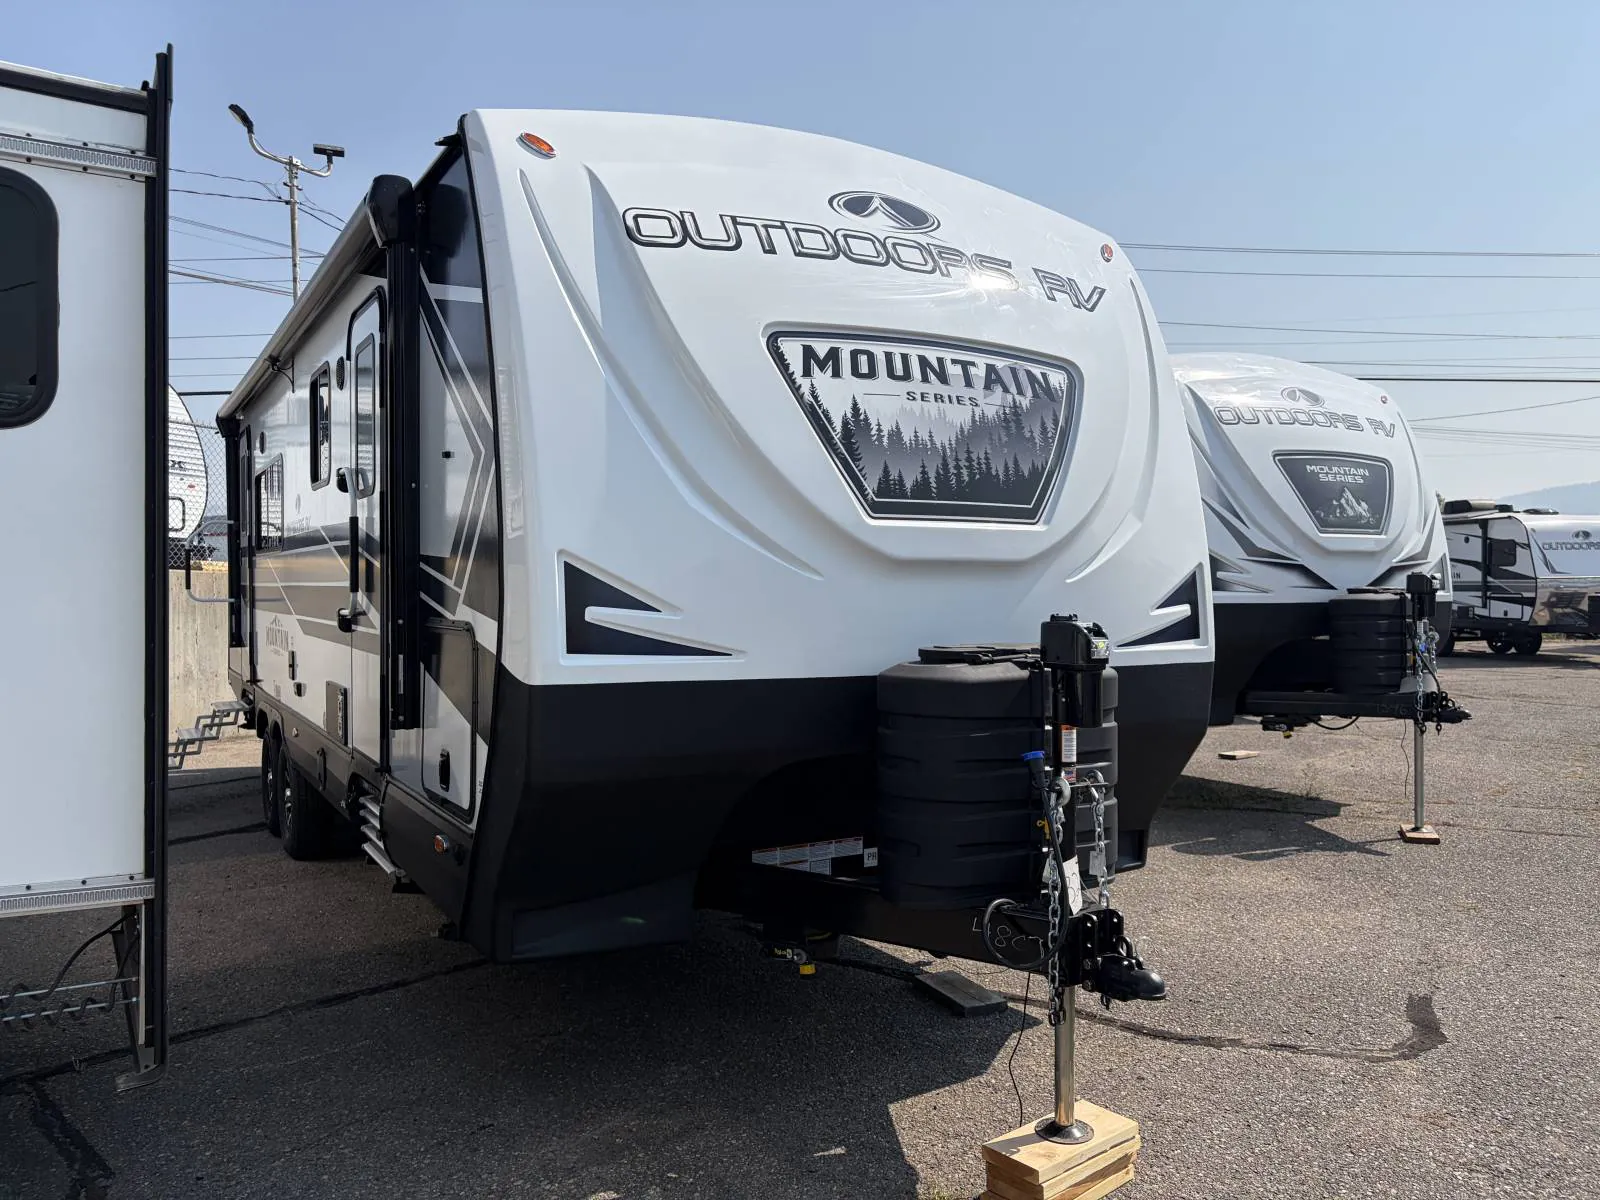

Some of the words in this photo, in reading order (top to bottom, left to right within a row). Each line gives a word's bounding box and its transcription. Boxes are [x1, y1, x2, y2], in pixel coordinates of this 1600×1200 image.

[622, 207, 1019, 291] OUTDOORS
[1031, 267, 1106, 312] RV
[801, 344, 1058, 402] MOUNTAIN
[906, 390, 980, 408] SERIES
[1214, 406, 1364, 432] OUTDOORS
[1365, 417, 1396, 438] RV
[1306, 464, 1370, 477] MOUNTAIN
[1318, 473, 1364, 484] SERIES
